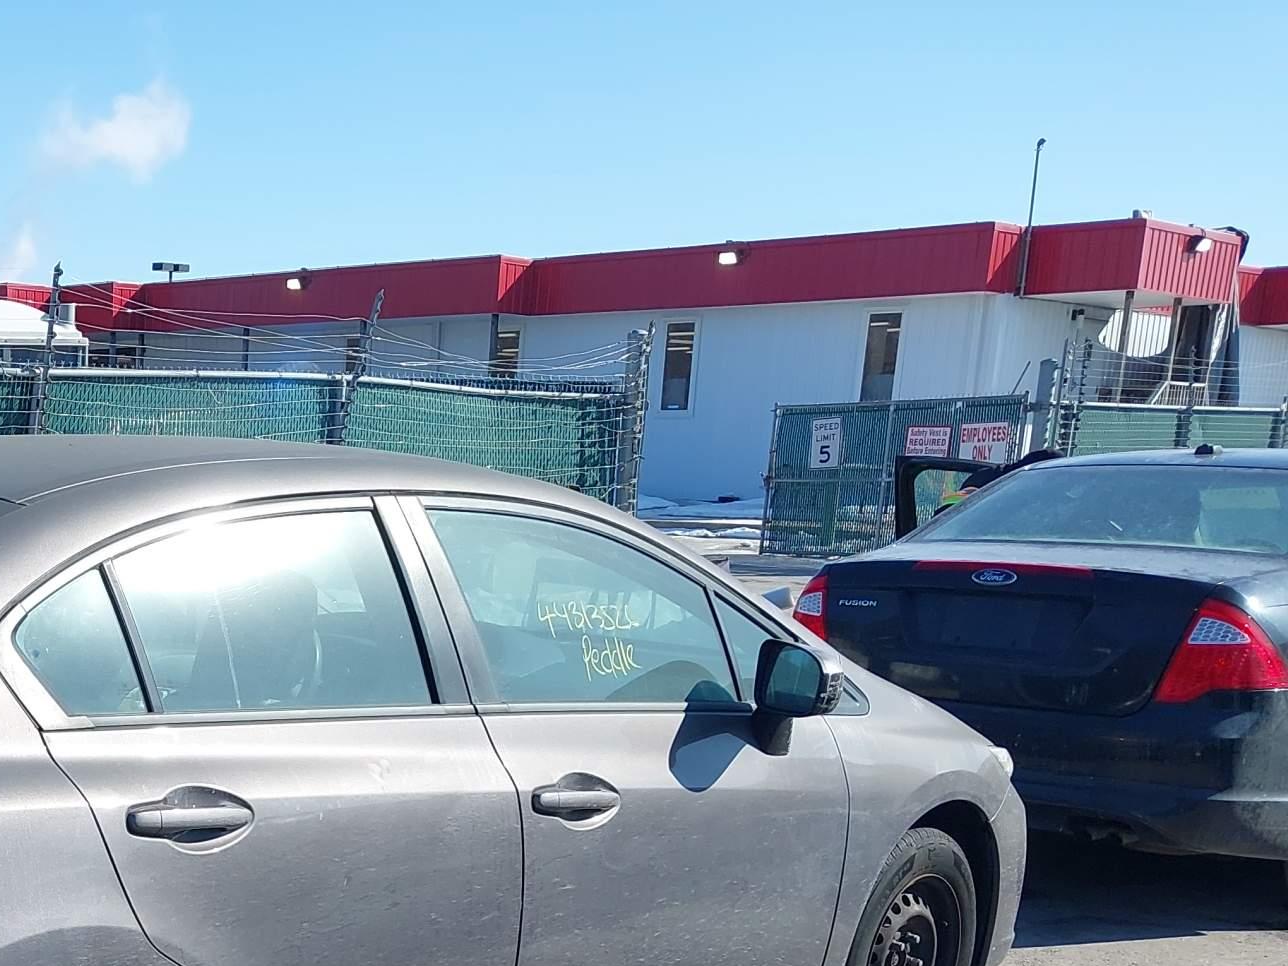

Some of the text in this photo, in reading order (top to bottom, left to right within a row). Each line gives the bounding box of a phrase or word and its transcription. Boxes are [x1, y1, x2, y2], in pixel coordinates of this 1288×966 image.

[814, 422, 840, 432] SPEED
[815, 433, 837, 443] LIMIT
[961, 426, 1007, 444] EMPLOYEES
[908, 438, 947, 447] REQUIRED
[819, 445, 831, 464] 5
[972, 444, 993, 461] ONLY
[838, 599, 878, 607] FUSION
